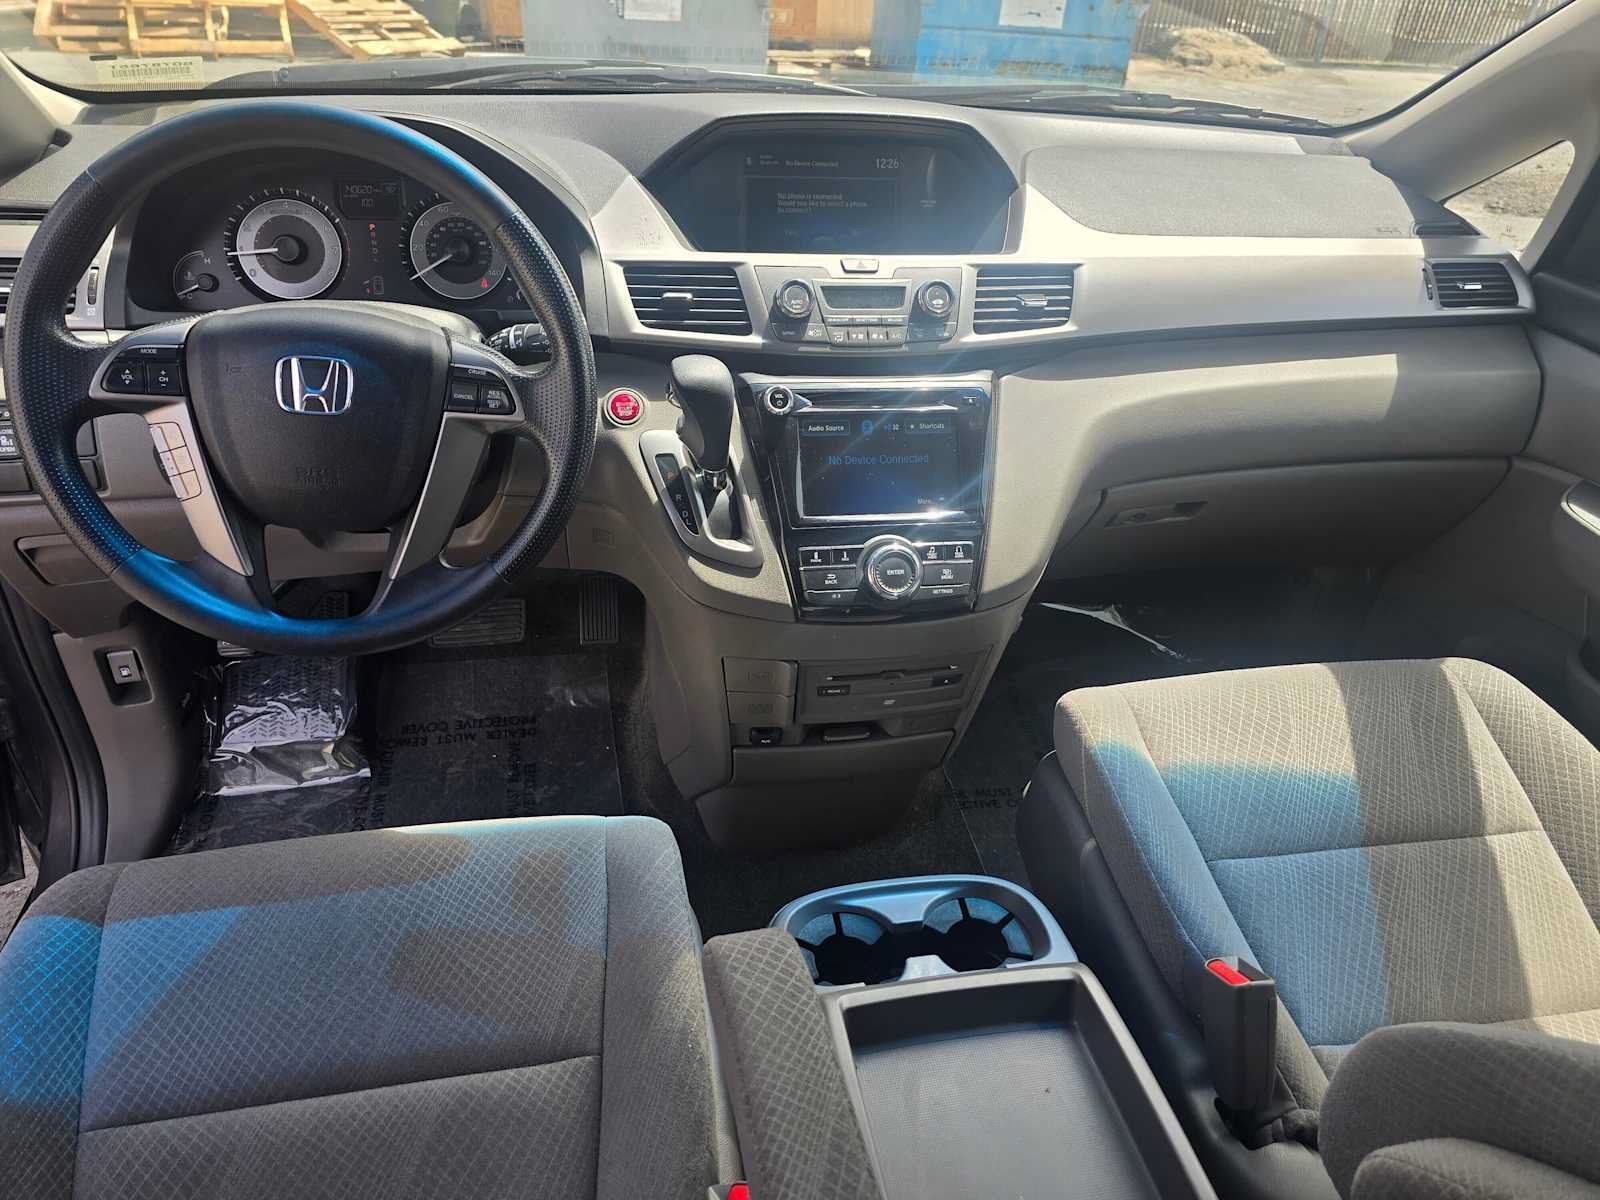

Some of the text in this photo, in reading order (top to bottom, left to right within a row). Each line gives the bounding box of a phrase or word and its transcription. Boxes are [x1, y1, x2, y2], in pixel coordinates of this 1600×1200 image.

[808, 424, 845, 432] Audio Source
[919, 422, 945, 430] Shortcuts
[828, 454, 929, 465] No Device Connected
[437, 732, 476, 745] MUST
